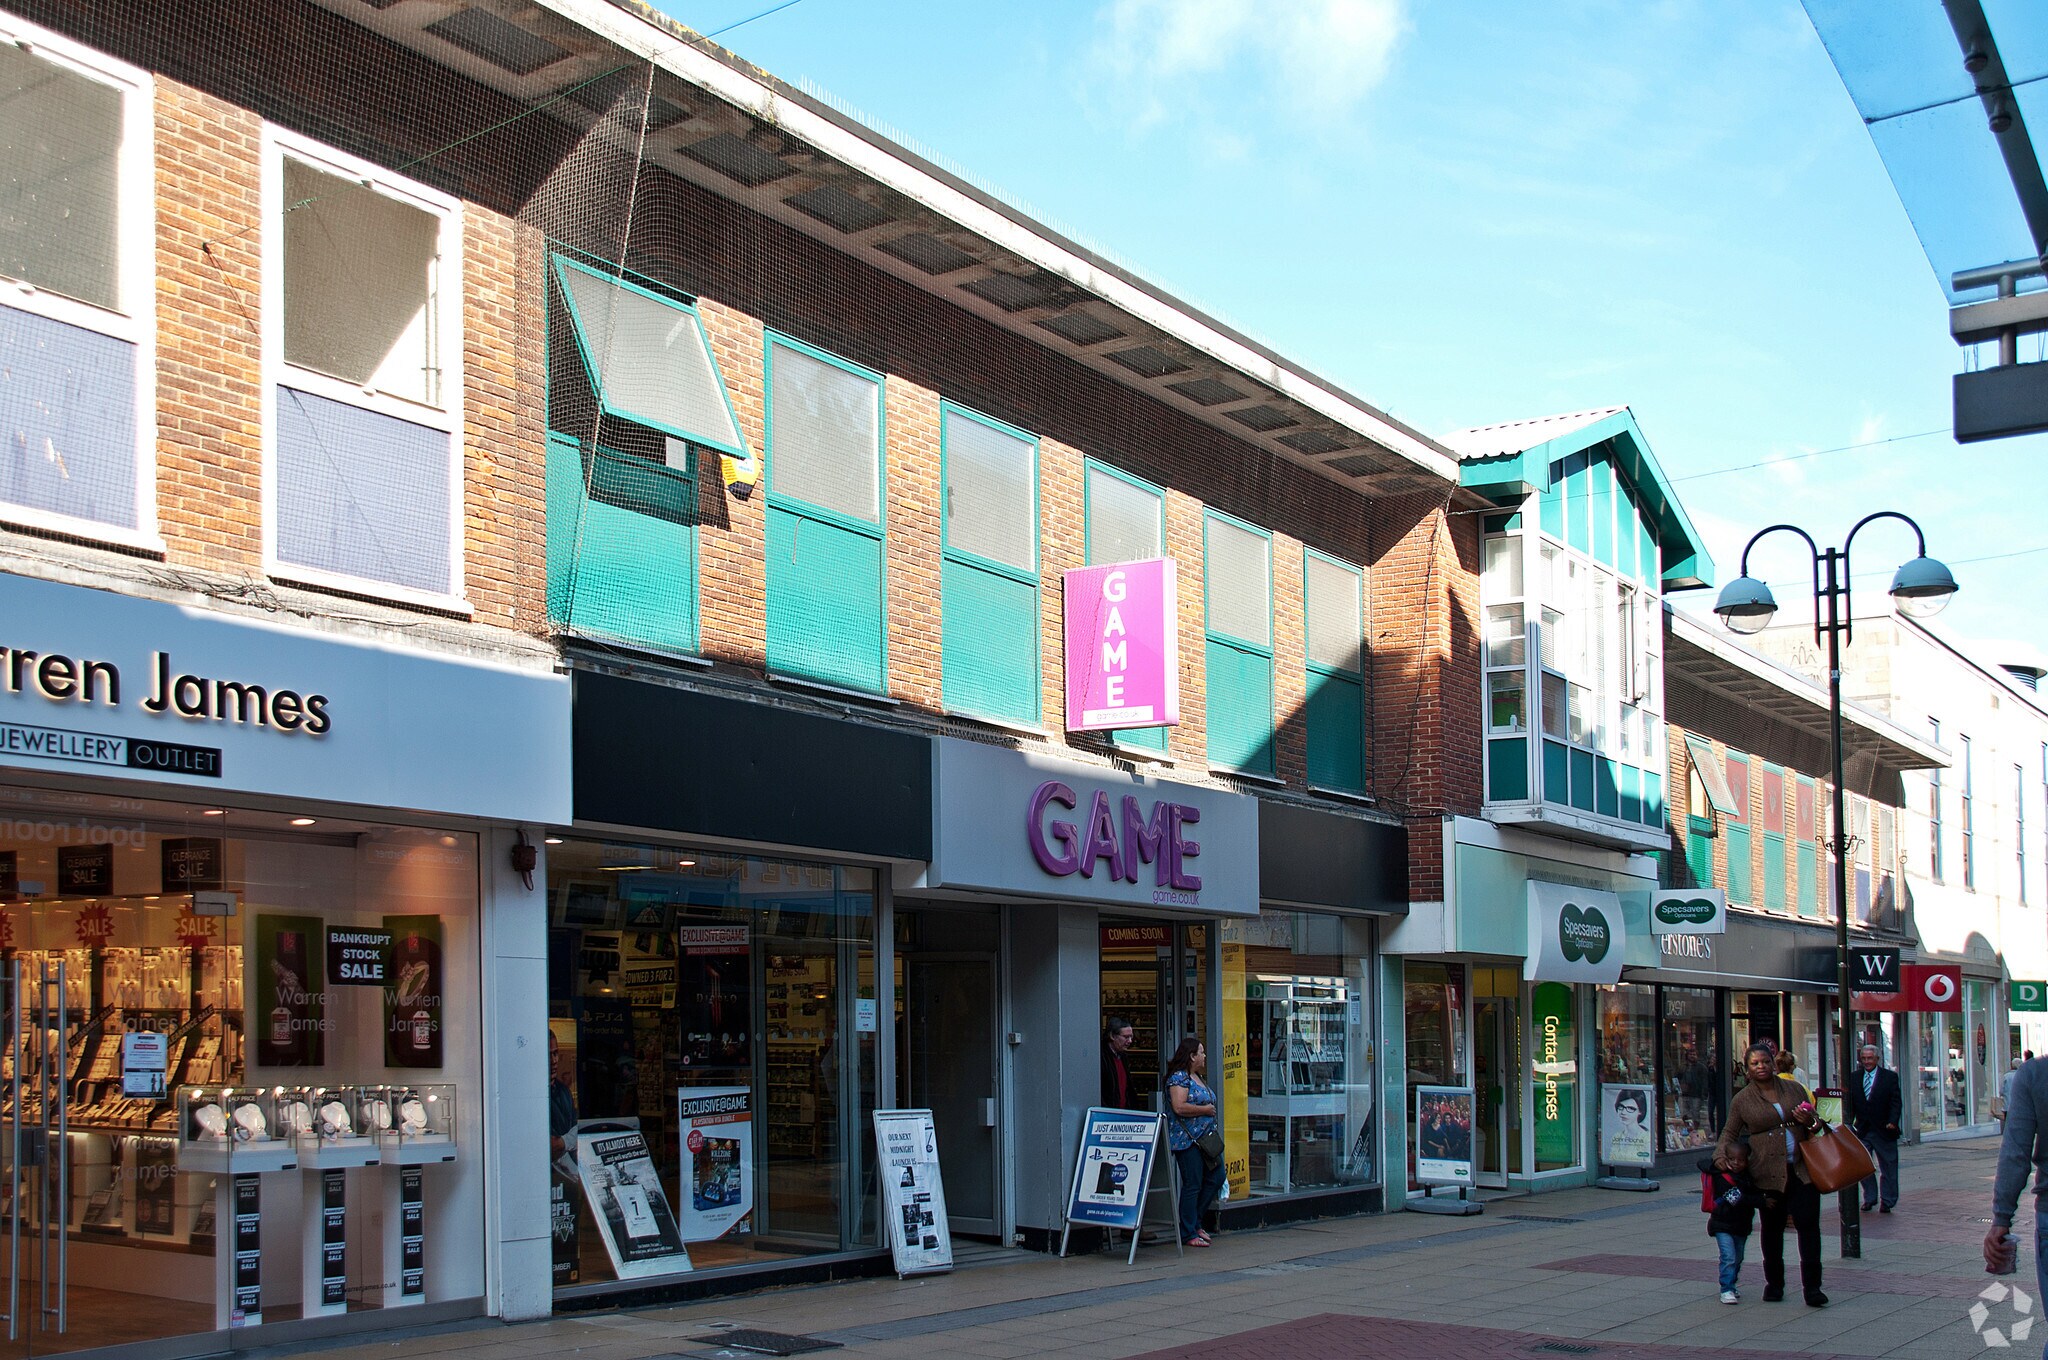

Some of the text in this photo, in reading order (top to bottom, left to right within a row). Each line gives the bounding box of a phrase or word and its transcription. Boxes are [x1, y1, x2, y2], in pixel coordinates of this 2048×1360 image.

[1103, 571, 1127, 708] GAME
[144, 651, 331, 735] James
[0, 729, 217, 771] JEWELLERY OUTLET
[1027, 780, 1202, 891] GAME
[67, 856, 104, 868] CLEARANCE
[171, 850, 211, 862] CLEARANCE
[72, 869, 98, 884] SALE
[178, 863, 204, 878] SALE
[1152, 890, 1200, 906] game.co.uk
[1661, 905, 1709, 914] Specsavers
[80, 920, 109, 936] SALE
[180, 918, 212, 936] SALE
[1108, 927, 1165, 941] COMING SOON
[1564, 917, 1604, 939] Specsavers
[331, 932, 391, 945] BANKRUPT
[343, 949, 380, 960] STOCK
[1661, 934, 1711, 960] erstone's
[340, 963, 384, 979] SALE
[1860, 955, 1890, 977] W
[1859, 978, 1893, 986] Waterstone's
[2019, 985, 2038, 1002] D
[1225, 1043, 1240, 1058] FOR 2
[1544, 1015, 1559, 1121] Contact Lenses
[682, 1095, 748, 1116] EXCLUSIVE@GAME
[1094, 1124, 1147, 1134] JUST ANNOUNCED!
[625, 1136, 642, 1147] HERE
[1107, 1151, 1139, 1162] PS4
[1229, 1161, 1240, 1175] FOR
[1240, 1158, 1245, 1171] 2
